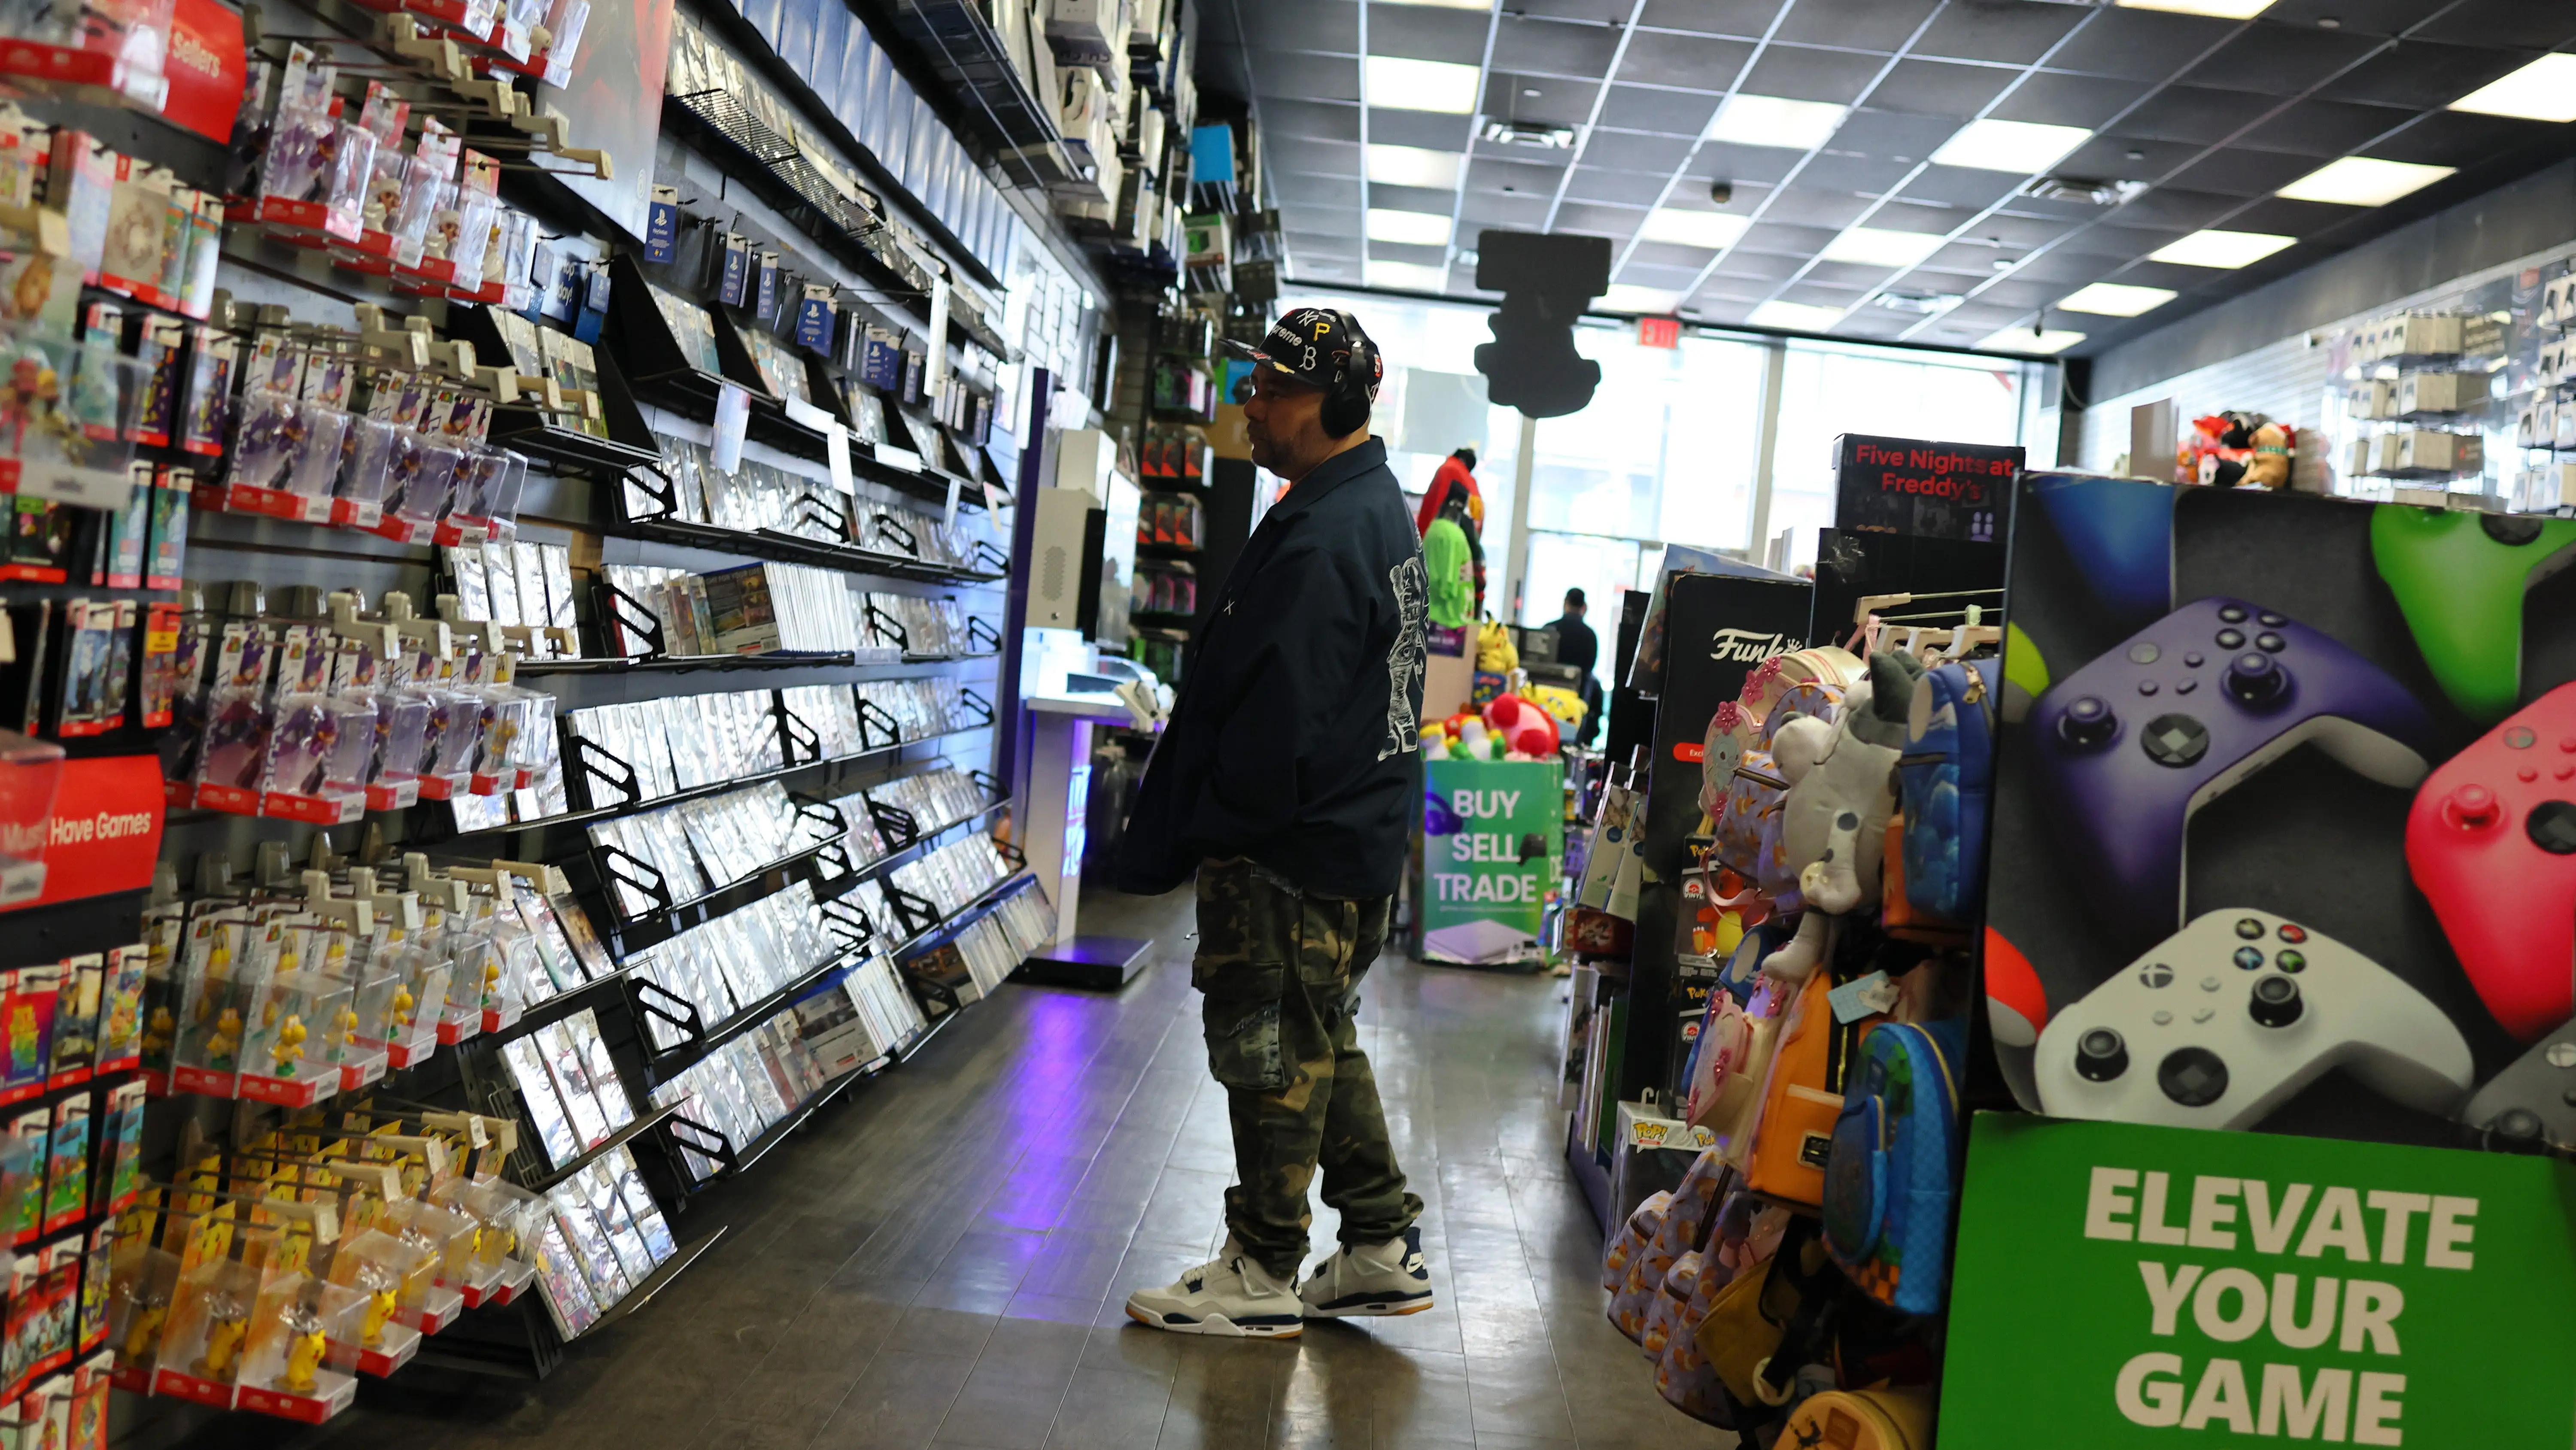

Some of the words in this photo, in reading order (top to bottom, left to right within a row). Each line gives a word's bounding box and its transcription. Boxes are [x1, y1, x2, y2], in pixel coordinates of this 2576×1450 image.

[1856, 444, 1905, 466] Five
[1909, 449, 1988, 475] Nights
[1989, 458, 2015, 477] at
[1881, 472, 1982, 501] Freddy's
[1689, 749, 1704, 758] Excl
[1453, 789, 1521, 819] BUY
[49, 816, 94, 846] Have
[96, 811, 152, 840] Games
[1452, 832, 1521, 862] SELL
[1433, 873, 1537, 903] TRADE
[1633, 1122, 1668, 1140] POP!
[2084, 1165, 2479, 1271] ELEVATE
[2137, 1260, 2406, 1356] YOUR
[2114, 1351, 2407, 1447] GAME
